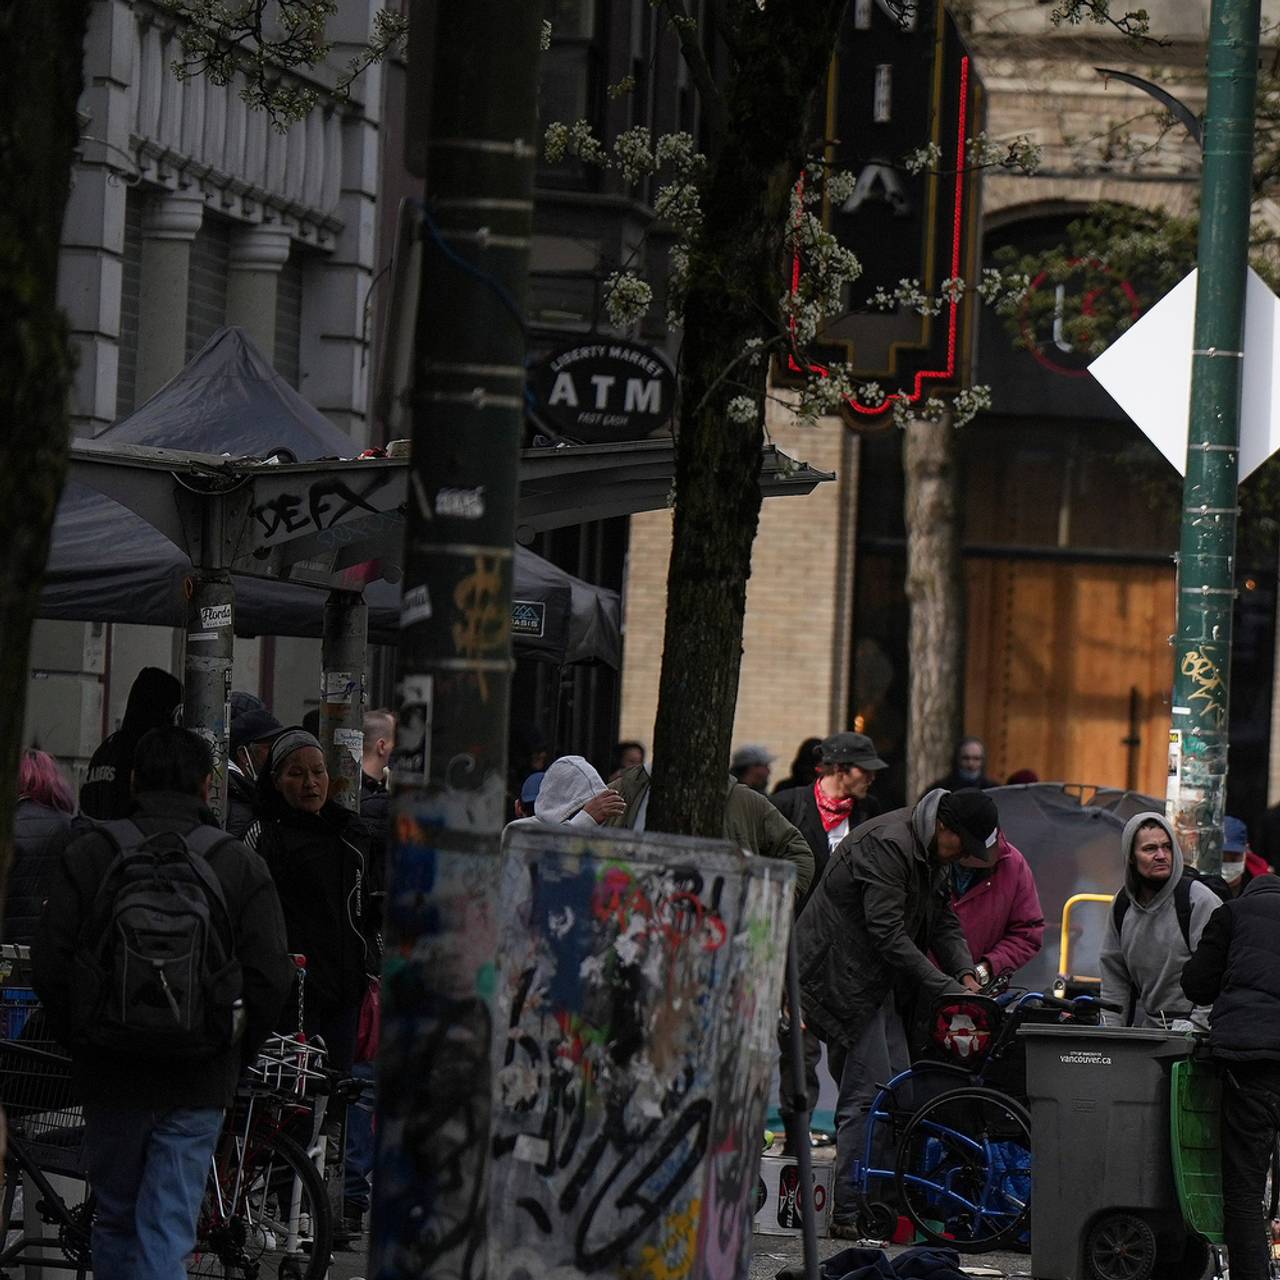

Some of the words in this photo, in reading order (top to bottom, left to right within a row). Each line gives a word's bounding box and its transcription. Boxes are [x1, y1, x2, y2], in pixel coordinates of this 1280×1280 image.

[550, 345, 607, 372] LIBERTY
[608, 346, 665, 377] MARKET
[548, 371, 662, 414] ATM
[1059, 1055, 1113, 1065] vancouver.ca
[786, 1189, 795, 1228] BLACK
